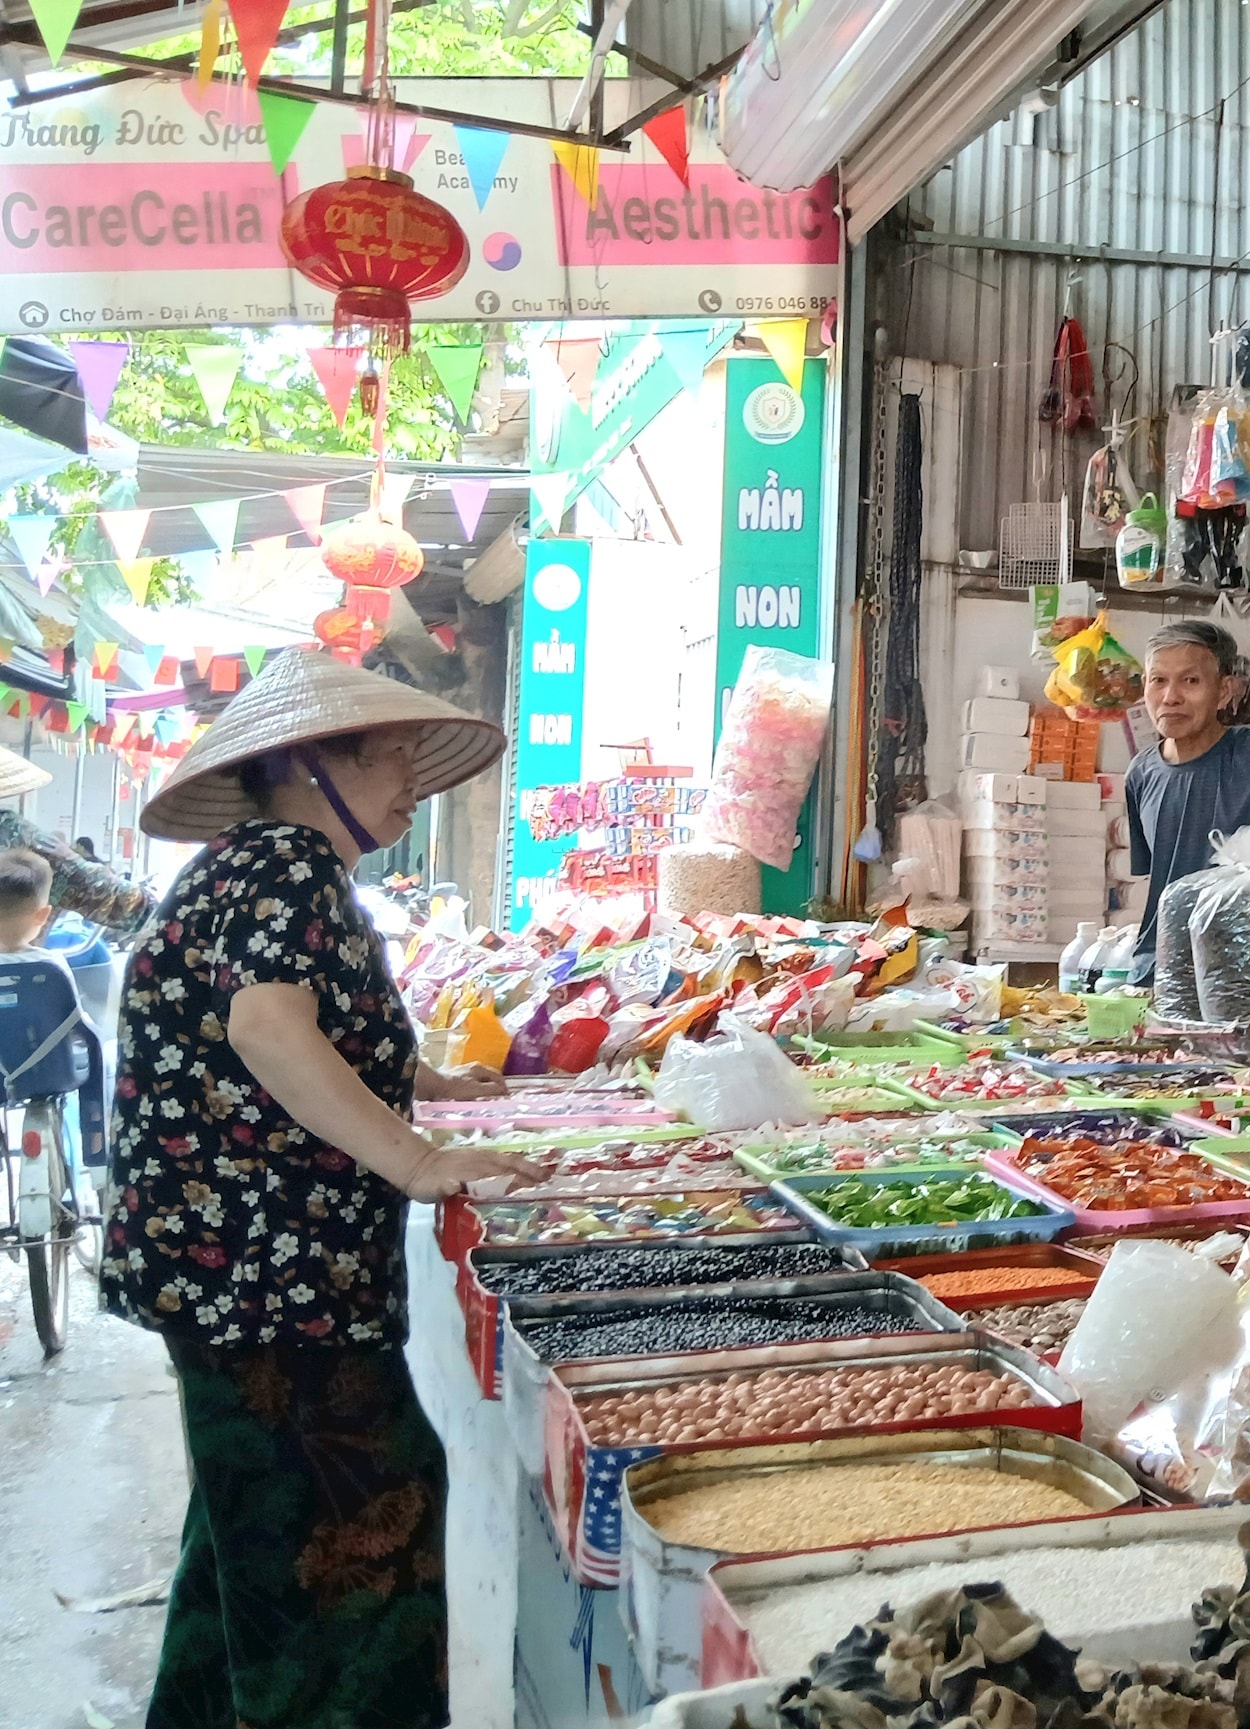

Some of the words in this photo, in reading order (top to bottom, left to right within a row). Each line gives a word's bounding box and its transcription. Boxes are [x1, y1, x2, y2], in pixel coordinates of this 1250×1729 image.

[0, 111, 103, 155] Trang
[116, 109, 186, 147] Đức
[199, 110, 267, 152] Spa
[437, 173, 518, 193] Acamy
[2, 190, 263, 249] CareCella
[585, 183, 823, 241] Aesthetic
[60, 308, 97, 325] Chợ
[160, 305, 188, 323] Đại
[244, 302, 297, 319] Thanh
[304, 301, 325, 316] Trì
[512, 299, 542, 312] Chu
[577, 297, 610, 312] Đức
[736, 297, 775, 311] 0976
[777, 296, 806, 310] 046
[738, 467, 804, 531] MẦM
[735, 585, 800, 628] NON
[529, 713, 572, 746] NON
